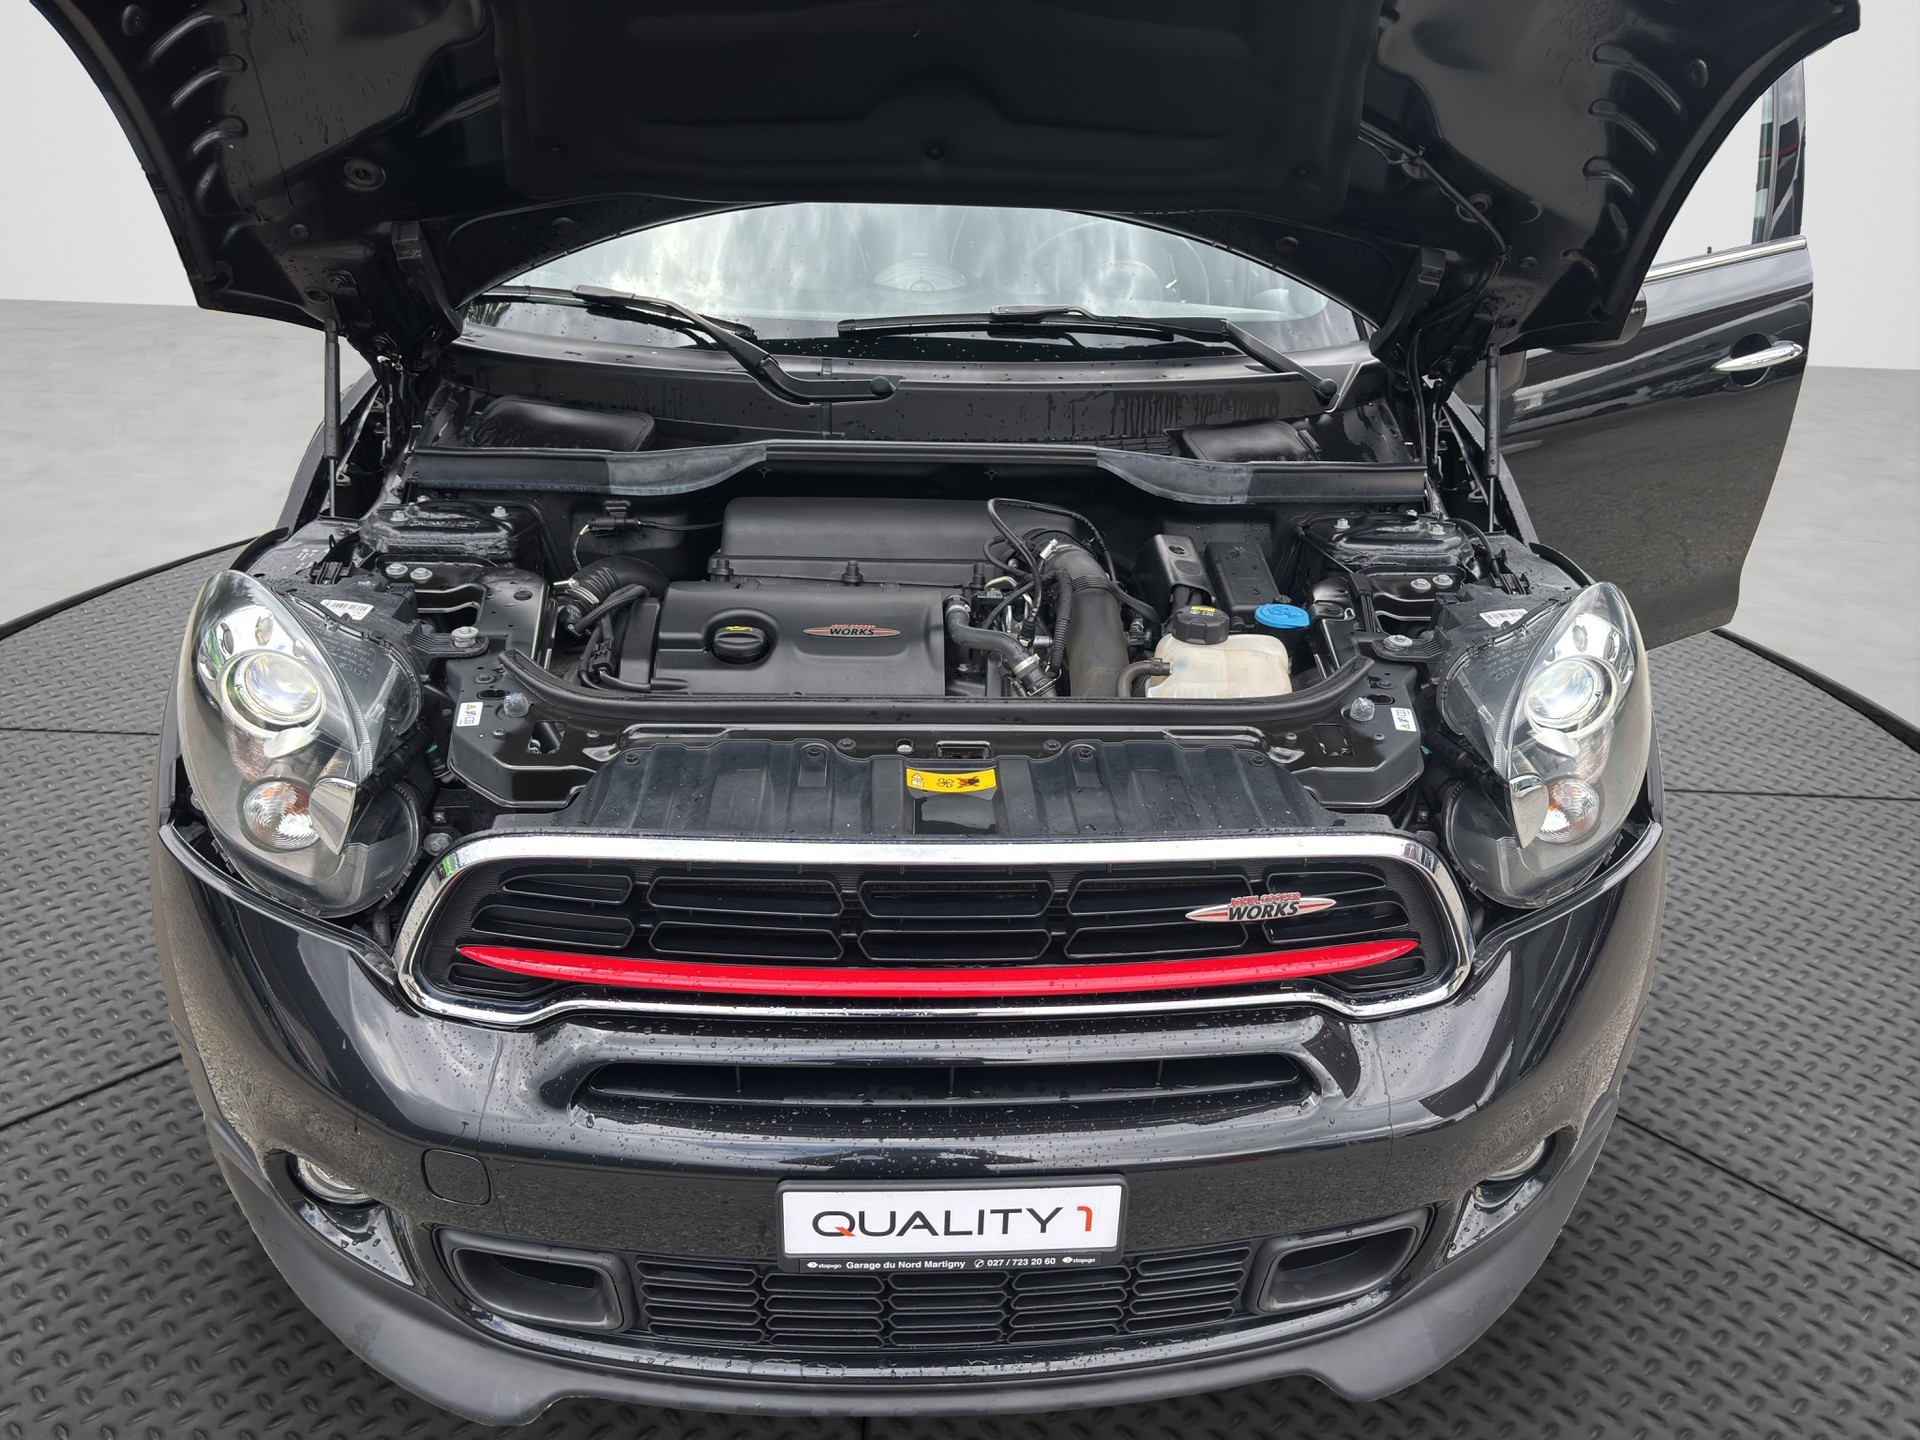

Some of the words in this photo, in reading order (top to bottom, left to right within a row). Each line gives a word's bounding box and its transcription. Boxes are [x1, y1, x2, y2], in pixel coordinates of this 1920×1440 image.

[1230, 895, 1259, 907] JOHN
[1260, 892, 1300, 904] COOPER
[1228, 901, 1299, 920] WORKS
[812, 1206, 1063, 1237] QUALITY
[1077, 1205, 1093, 1232] 1
[846, 1261, 881, 1270] Garage
[883, 1261, 896, 1269] du
[898, 1261, 921, 1269] Nord
[924, 1260, 966, 1270] Martigny
[987, 1259, 1003, 1267] 027
[1005, 1259, 1011, 1267] /
[1012, 1259, 1028, 1267] 723
[1044, 1257, 1056, 1265] 60
